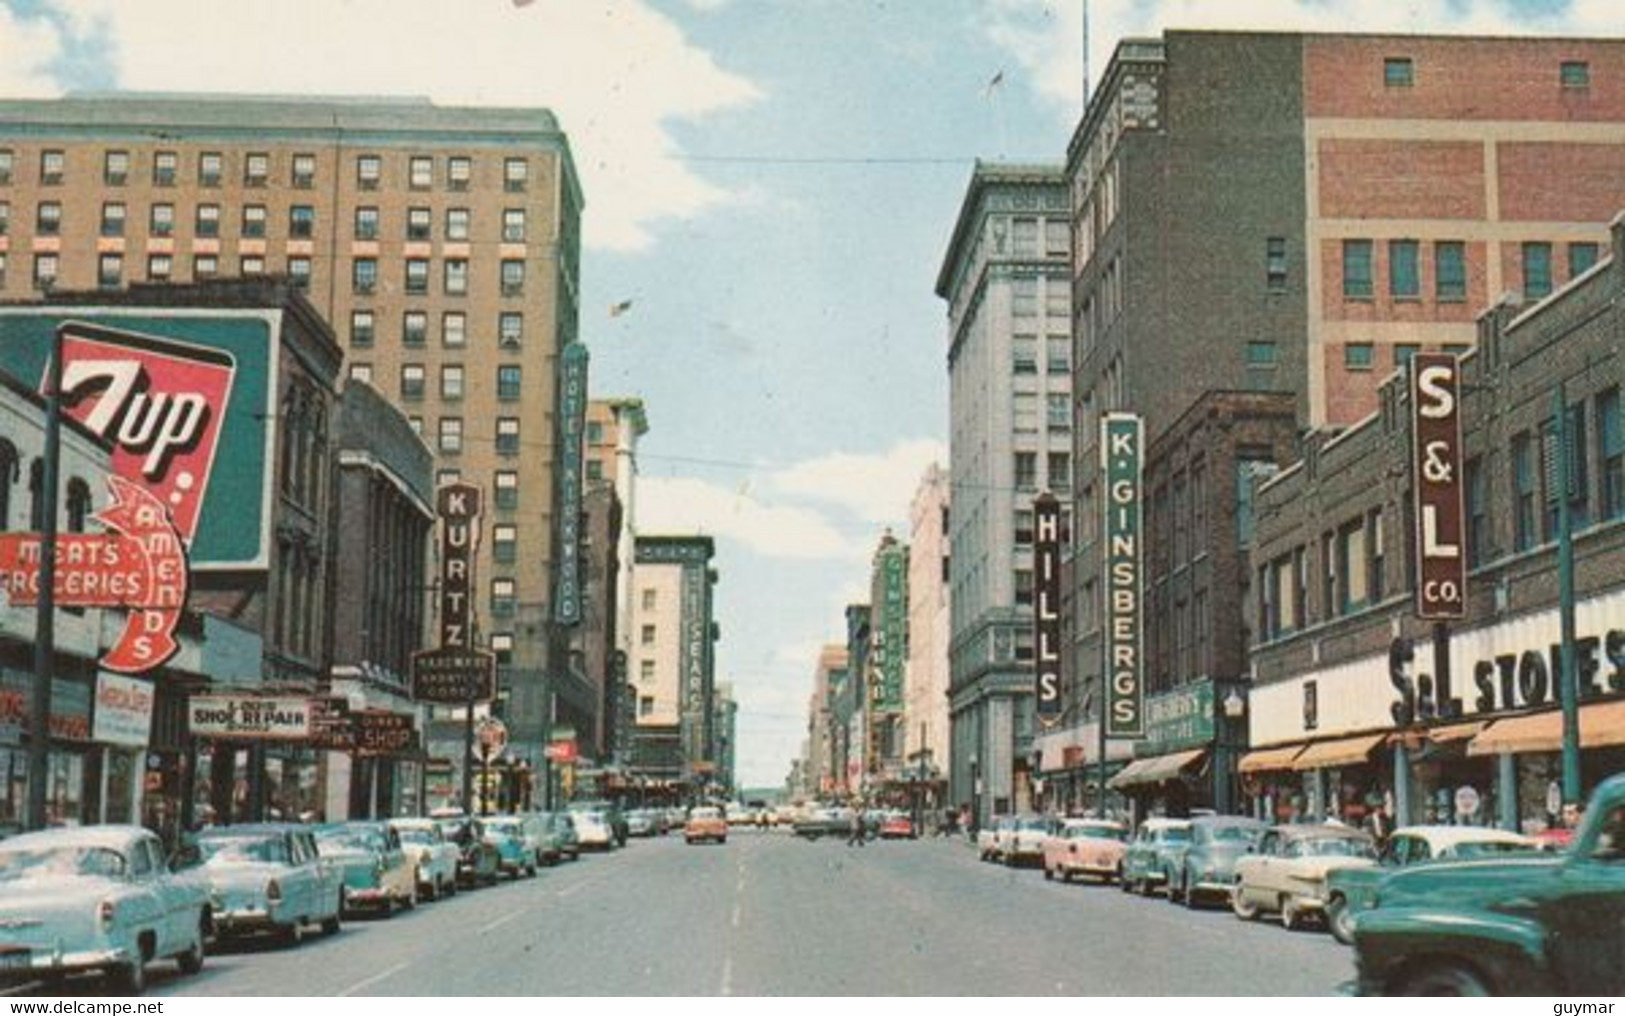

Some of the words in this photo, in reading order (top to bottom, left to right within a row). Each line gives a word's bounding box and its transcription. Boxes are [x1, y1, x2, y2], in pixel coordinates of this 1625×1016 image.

[446, 492, 467, 646] KURTZ
[1038, 513, 1058, 701] HILLS
[1112, 480, 1136, 723] GINSBERGS
[1424, 581, 1460, 602] CO.
[194, 709, 236, 725] SHOE
[242, 708, 305, 726] REPAIR
[364, 728, 411, 747] SHOP
